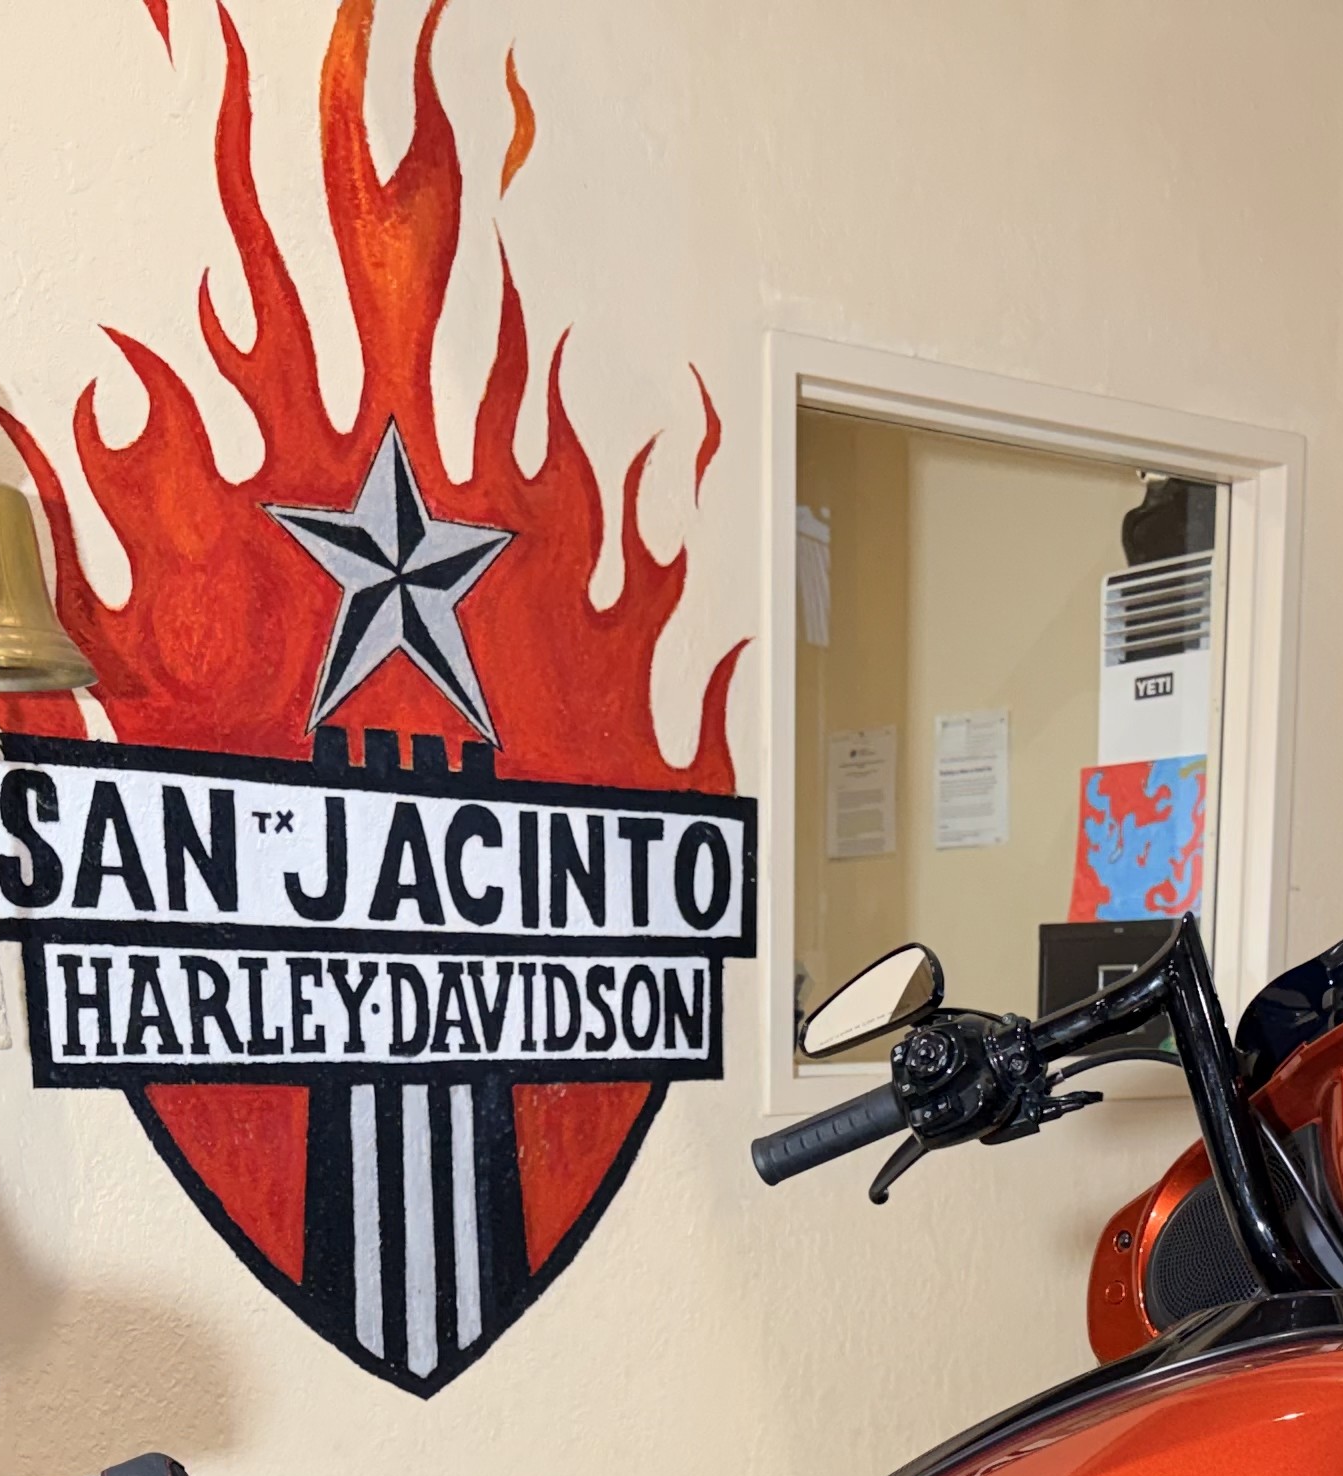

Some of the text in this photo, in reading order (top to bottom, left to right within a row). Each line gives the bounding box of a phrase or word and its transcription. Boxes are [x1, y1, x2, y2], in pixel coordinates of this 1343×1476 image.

[1136, 676, 1172, 697] YETI
[251, 809, 295, 835] TX
[284, 795, 732, 932] JACINTO
